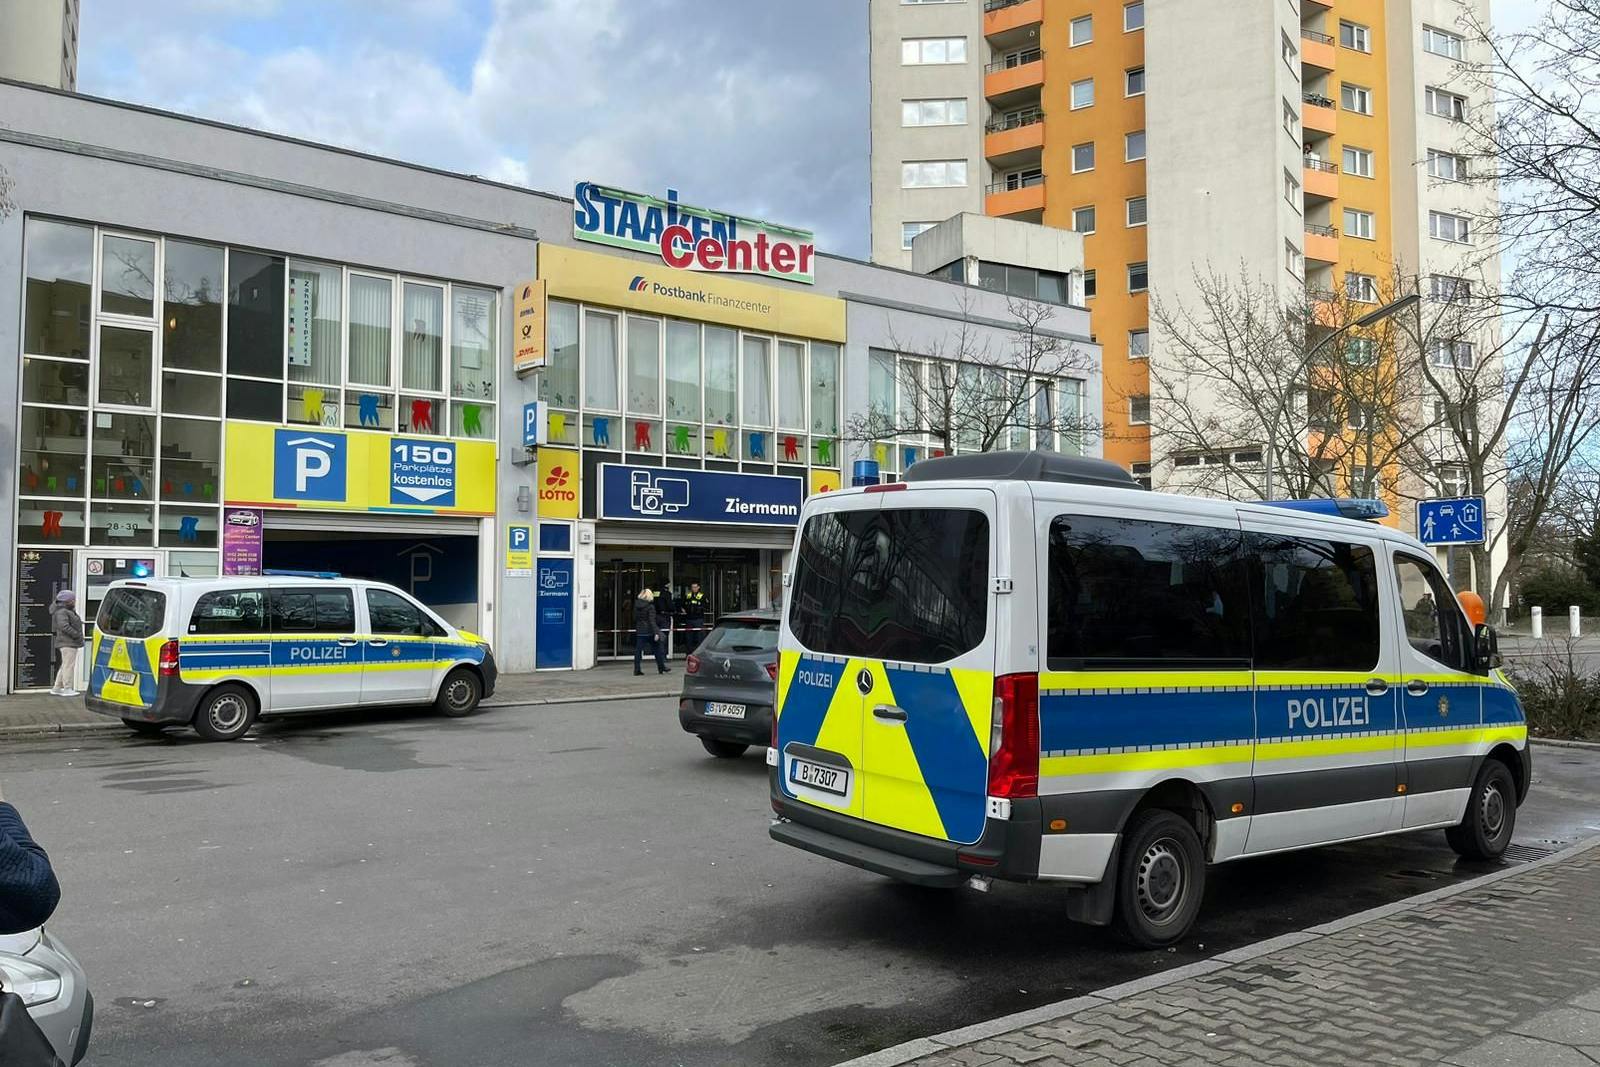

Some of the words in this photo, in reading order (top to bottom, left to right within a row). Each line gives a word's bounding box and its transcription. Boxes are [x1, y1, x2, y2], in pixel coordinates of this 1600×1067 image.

[661, 225, 813, 273] Center
[653, 283, 706, 303] Postbank
[708, 293, 771, 314] Finanzcenter
[527, 409, 535, 432] P
[394, 445, 452, 465] 150
[296, 448, 331, 492] P
[393, 462, 453, 474] Parkplätze
[393, 473, 453, 487] kostenlos
[540, 490, 575, 501] LOTTO
[725, 498, 797, 515] Ziermann
[515, 532, 525, 545] P
[290, 647, 347, 660] POLIZEI
[799, 670, 833, 688] POLIZEI
[1287, 696, 1370, 729] POLIZEI
[802, 765, 809, 780] B
[814, 768, 838, 787] 7307
